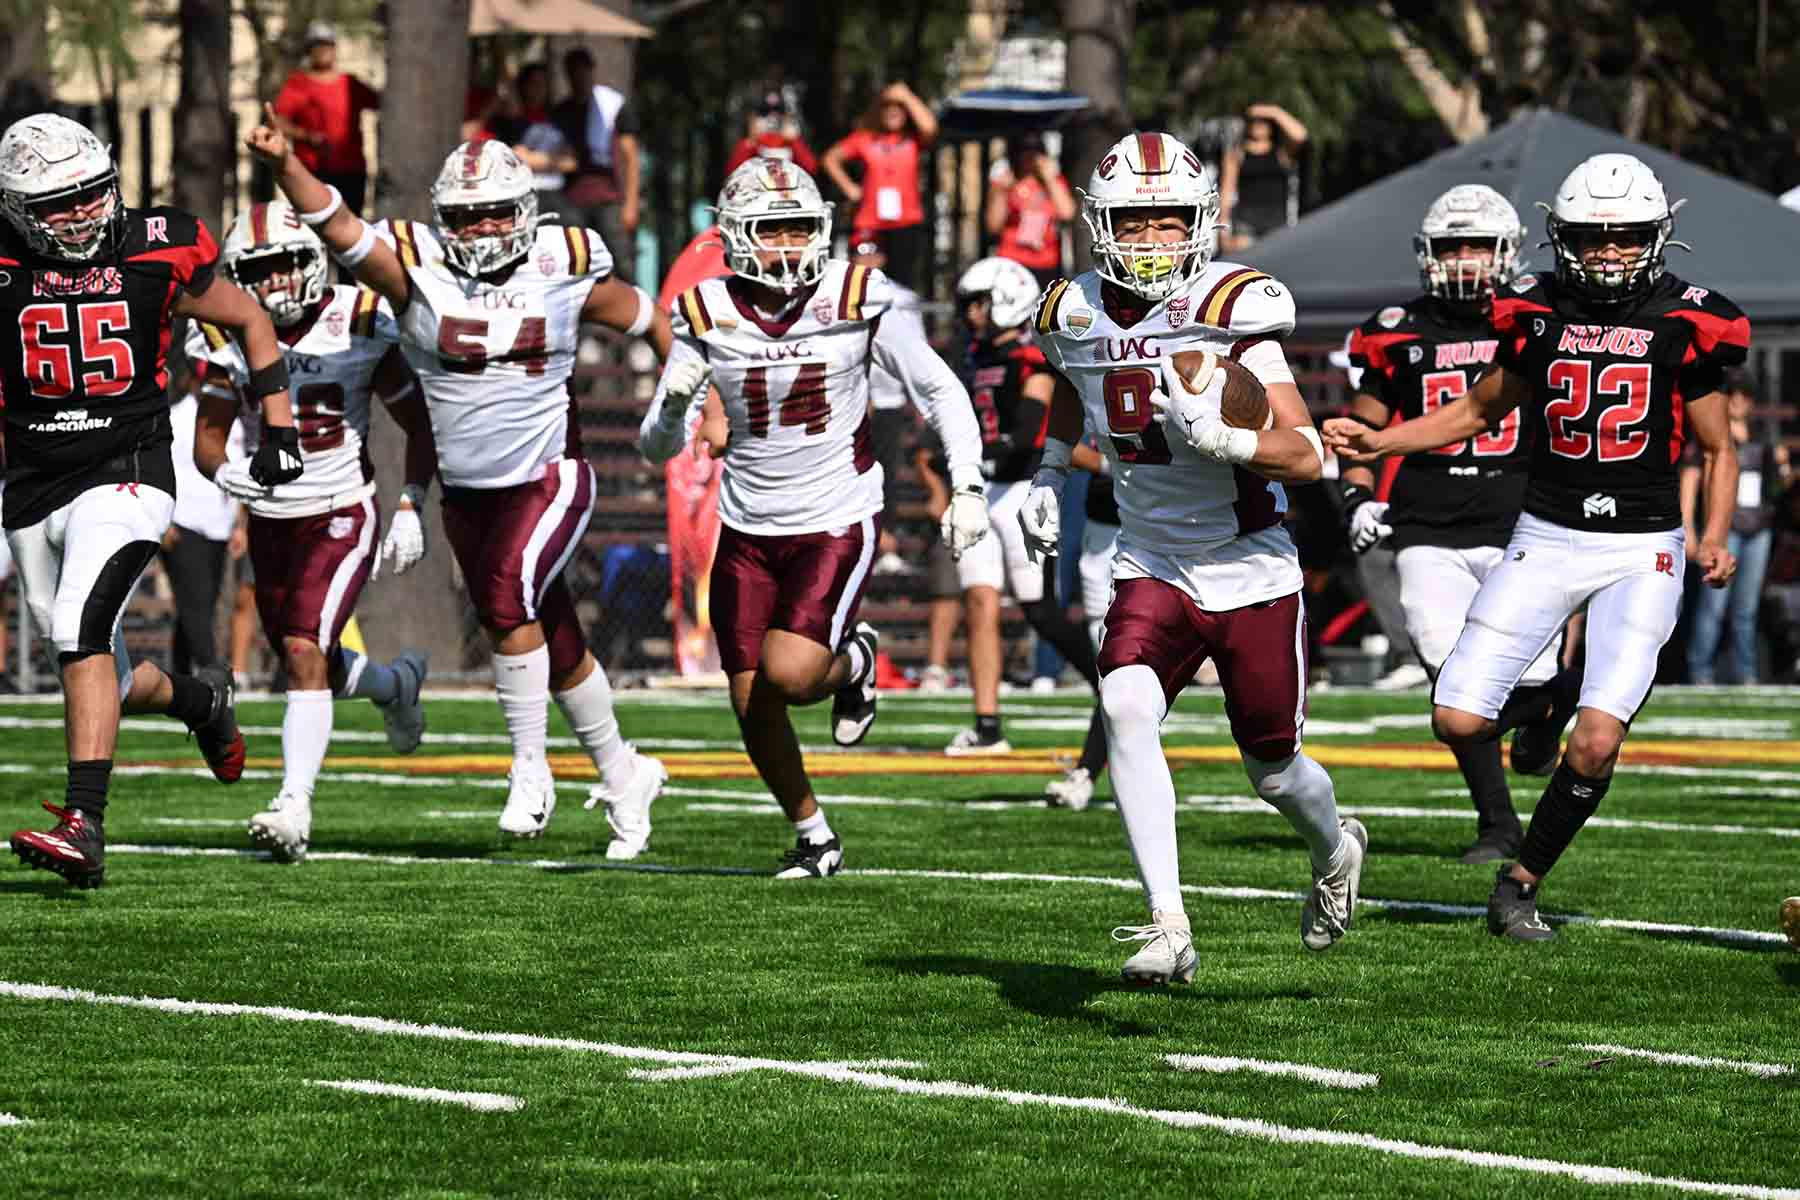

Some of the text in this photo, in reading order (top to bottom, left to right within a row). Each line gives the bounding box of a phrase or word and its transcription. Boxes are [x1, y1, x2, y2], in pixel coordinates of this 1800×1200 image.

[1136, 186, 1170, 195] Riddell
[145, 216, 169, 243] R
[1682, 286, 1708, 305] R
[1167, 310, 1189, 321] TECOS
[18, 300, 135, 399] 65
[436, 314, 547, 376] 54
[766, 340, 813, 361] UAG
[1108, 335, 1161, 362] UAG
[1558, 323, 1654, 357] ROJOS
[1435, 340, 1500, 369] ROJO
[742, 362, 832, 438] 14
[1544, 358, 1652, 462] 22
[1655, 552, 1675, 577] R
